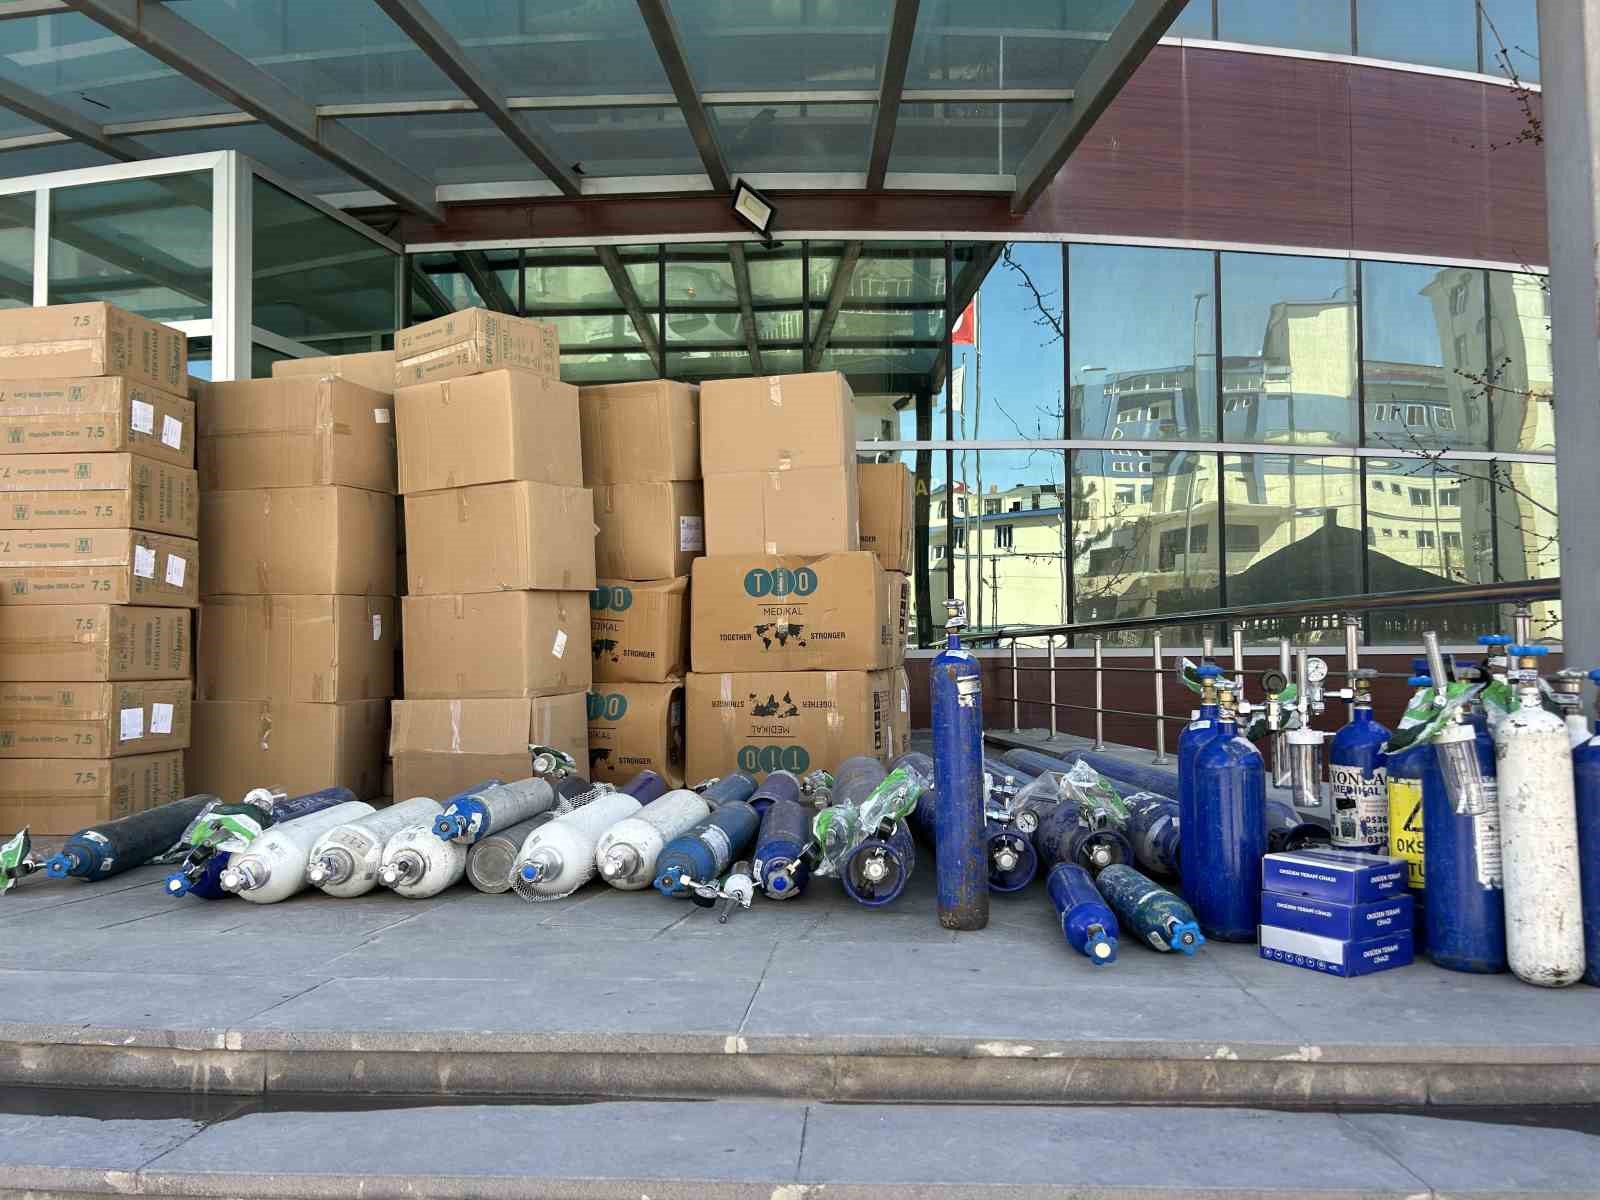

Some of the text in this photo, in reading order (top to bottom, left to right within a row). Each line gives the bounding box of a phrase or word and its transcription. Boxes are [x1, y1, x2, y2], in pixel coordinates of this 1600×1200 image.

[73, 315, 91, 327] 7.5
[86, 426, 105, 438] 7.5
[94, 505, 113, 517] 7.5
[92, 580, 112, 591] 7.5
[75, 618, 94, 630] 7.5
[719, 631, 846, 641] TOGETHER STRONGER
[623, 649, 656, 659] STRONGER
[74, 733, 93, 745] 7.5
[618, 756, 653, 765] STRONGER
[1396, 838, 1424, 855] OKS
